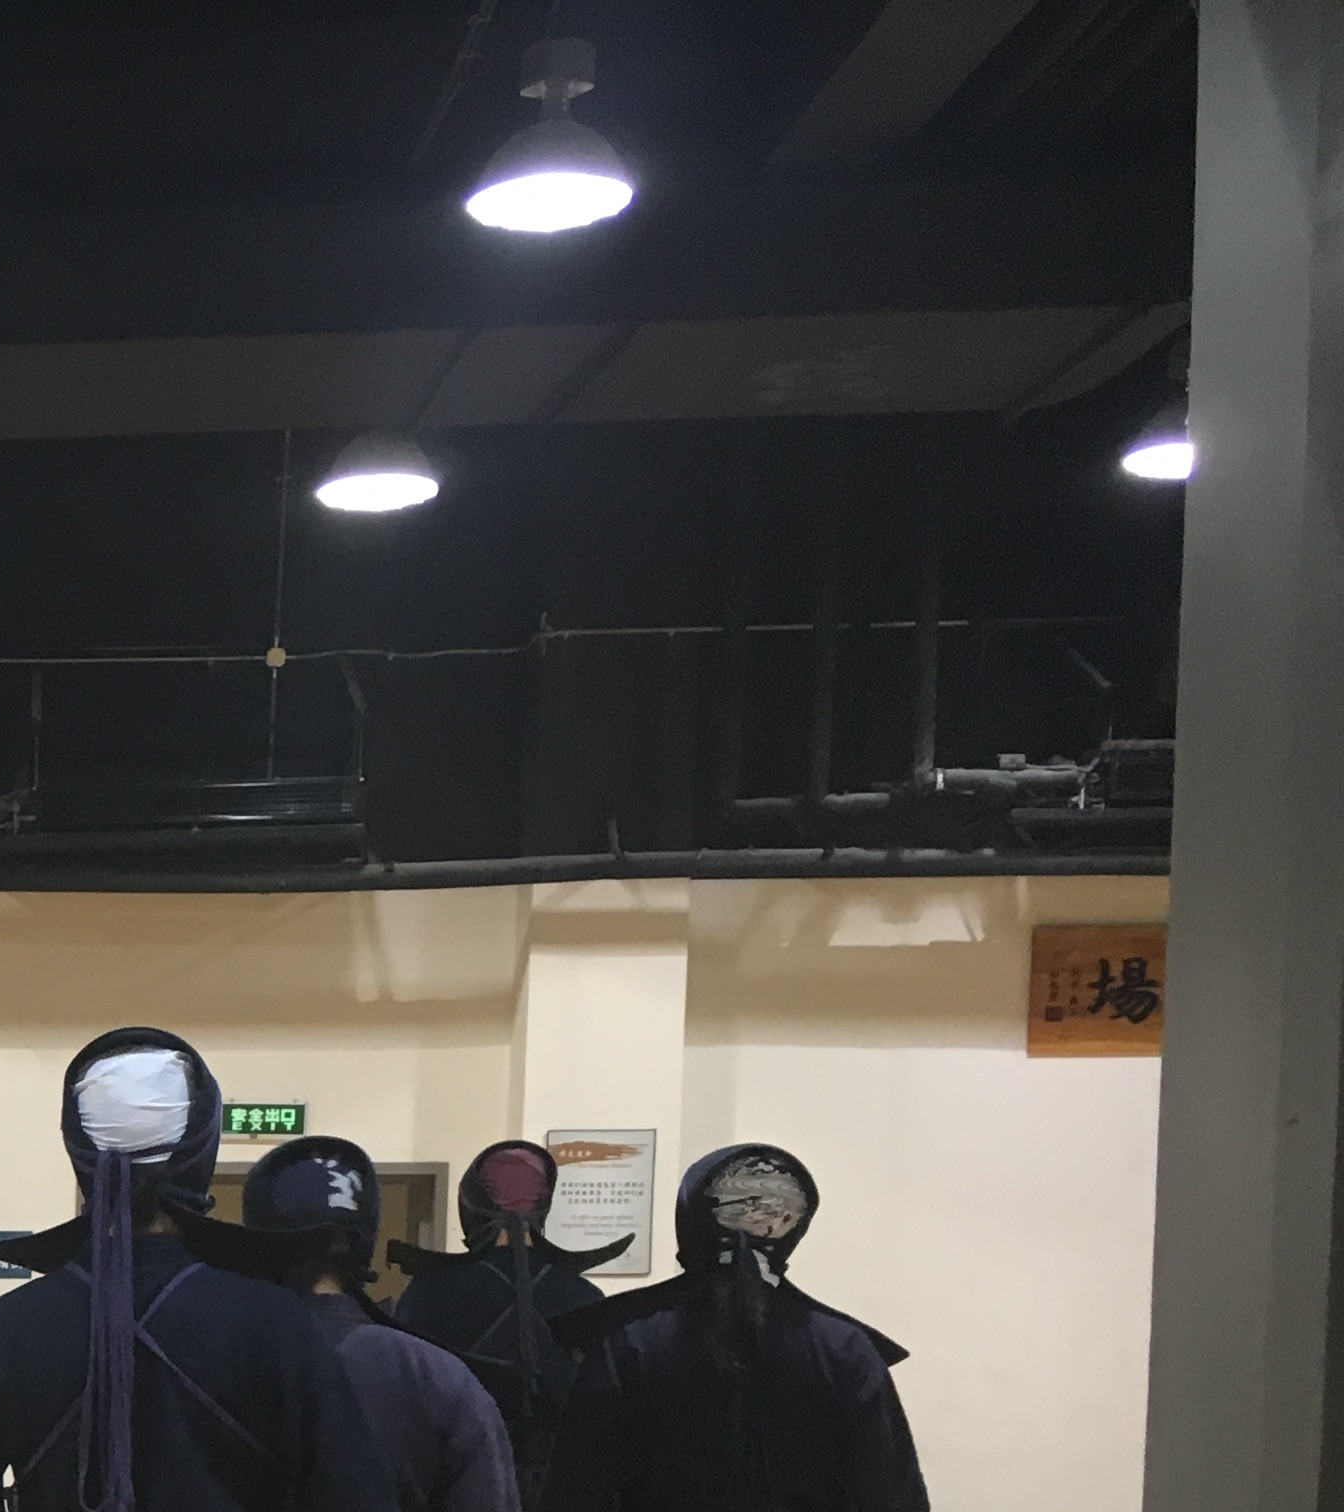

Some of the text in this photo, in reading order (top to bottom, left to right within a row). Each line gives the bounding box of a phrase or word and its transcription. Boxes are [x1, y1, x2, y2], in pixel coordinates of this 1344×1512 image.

[1087, 956, 1160, 1024] 場
[231, 1108, 296, 1122] 安全出口
[231, 1121, 296, 1131] EXIT
